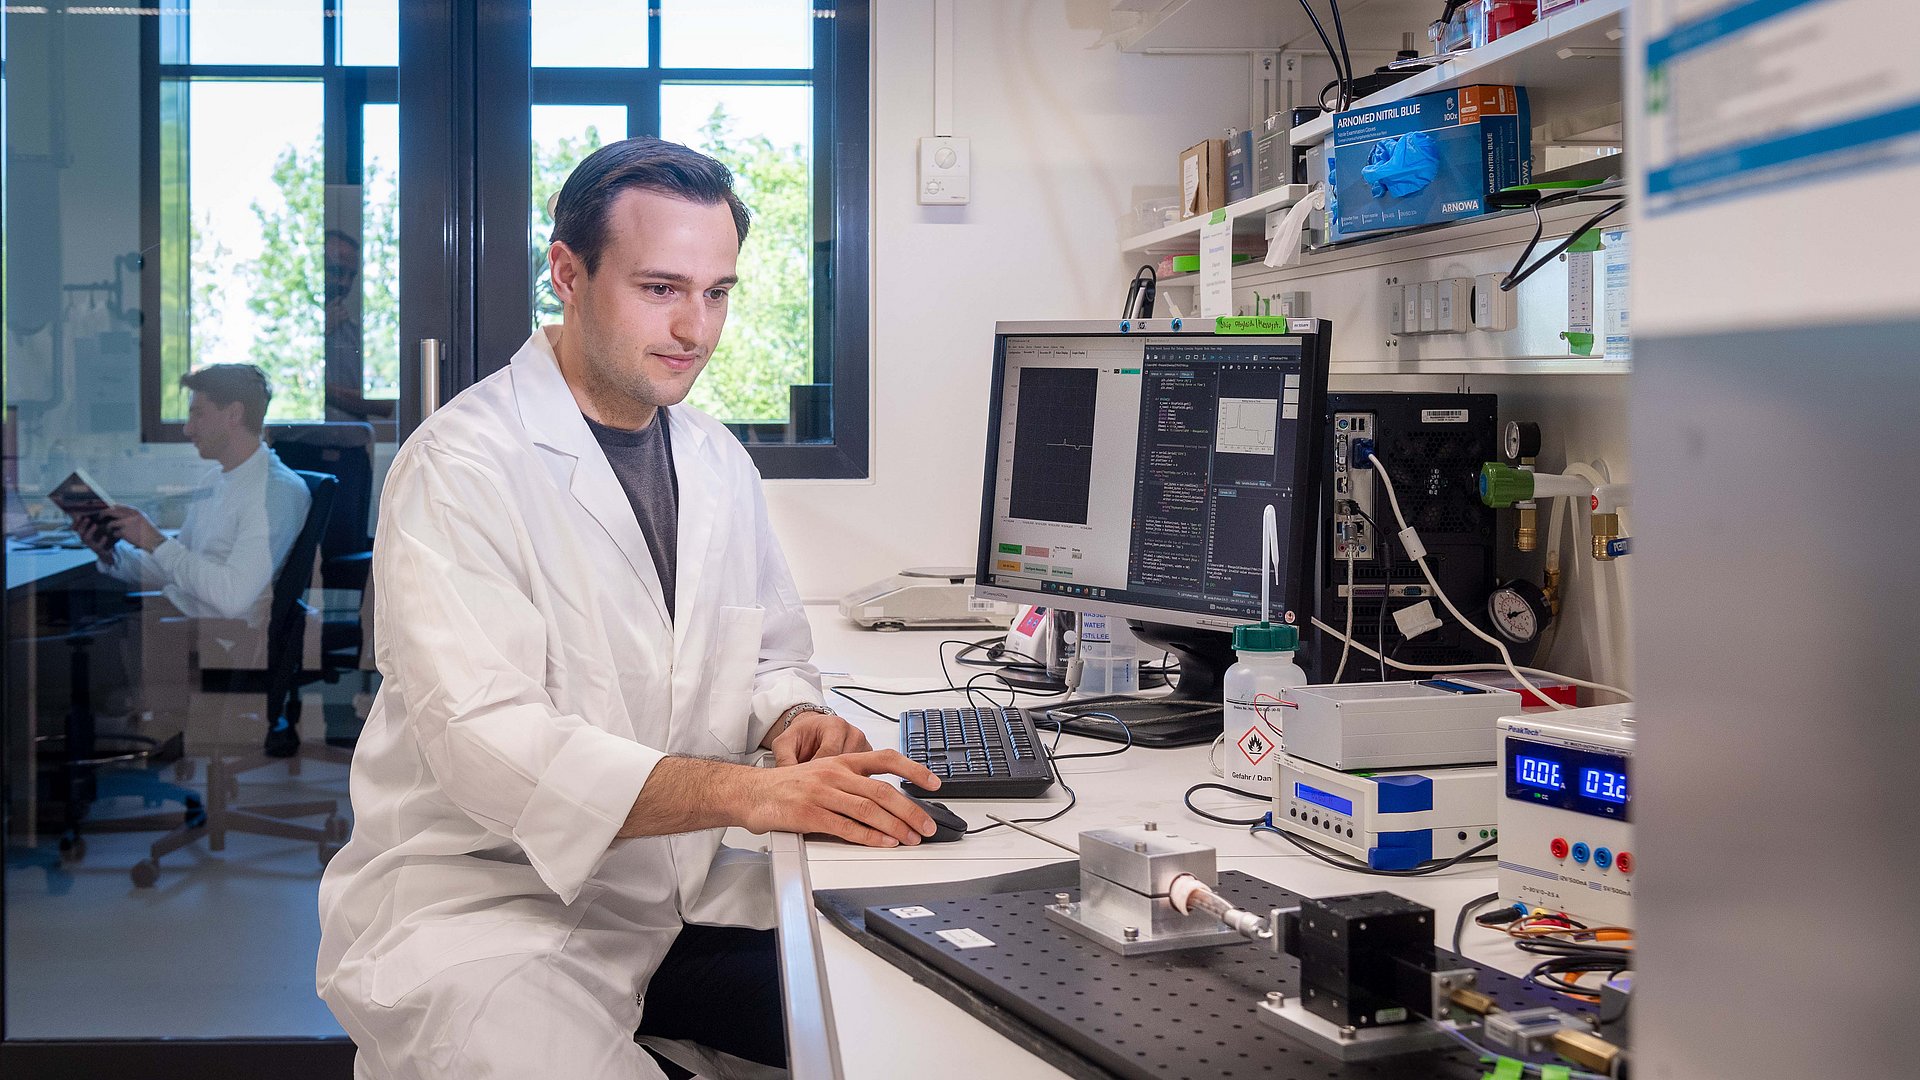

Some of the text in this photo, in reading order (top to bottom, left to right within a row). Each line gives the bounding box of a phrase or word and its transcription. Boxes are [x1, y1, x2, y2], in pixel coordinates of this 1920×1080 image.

[1465, 91, 1472, 104] L
[1337, 103, 1421, 129] ARNOMED NITRIL BLUE
[1444, 113, 1458, 121] 100x
[1441, 200, 1479, 213] ARNOWA
[1083, 621, 1106, 629] WATER
[1508, 725, 1539, 736] PeakTech
[1231, 771, 1252, 781] Gefahr
[1559, 875, 1588, 887] 12V/500mA
[1602, 885, 1632, 897] 5V/500mA
